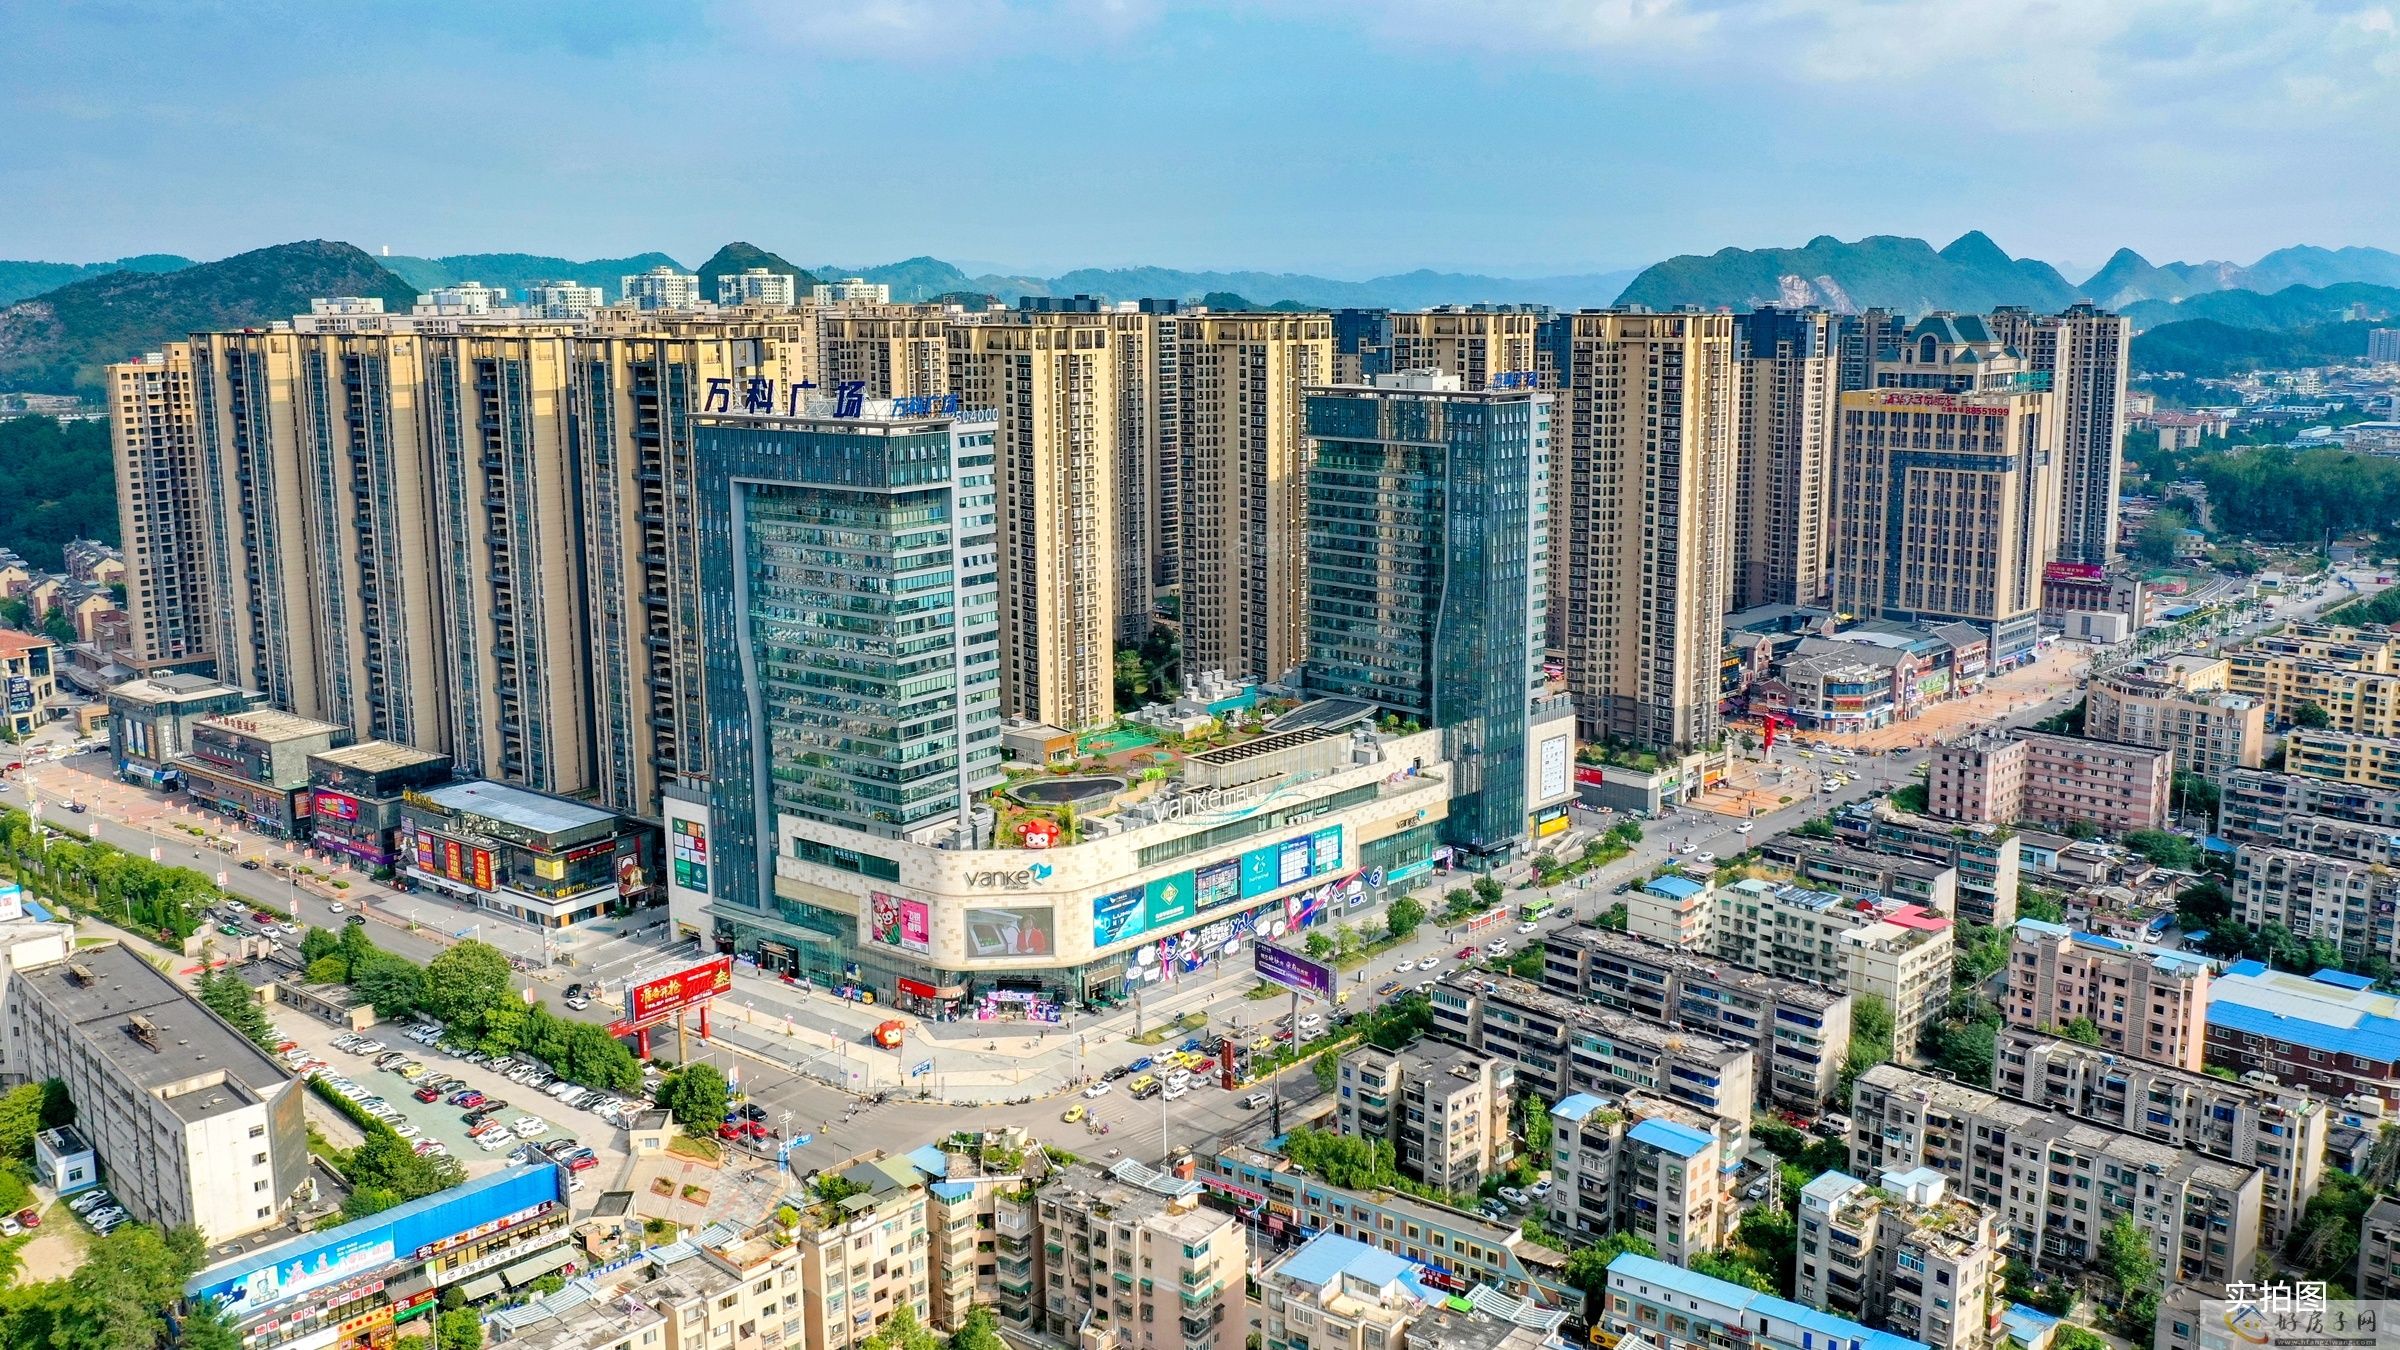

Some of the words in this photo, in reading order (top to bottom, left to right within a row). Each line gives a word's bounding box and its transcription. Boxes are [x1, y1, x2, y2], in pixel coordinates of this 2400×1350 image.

[704, 377, 866, 418] 万科广场
[892, 393, 959, 417] 万科广场
[1965, 407, 2010, 416] 88551999
[1152, 789, 1222, 825] vanke
[965, 870, 1030, 887] vanke
